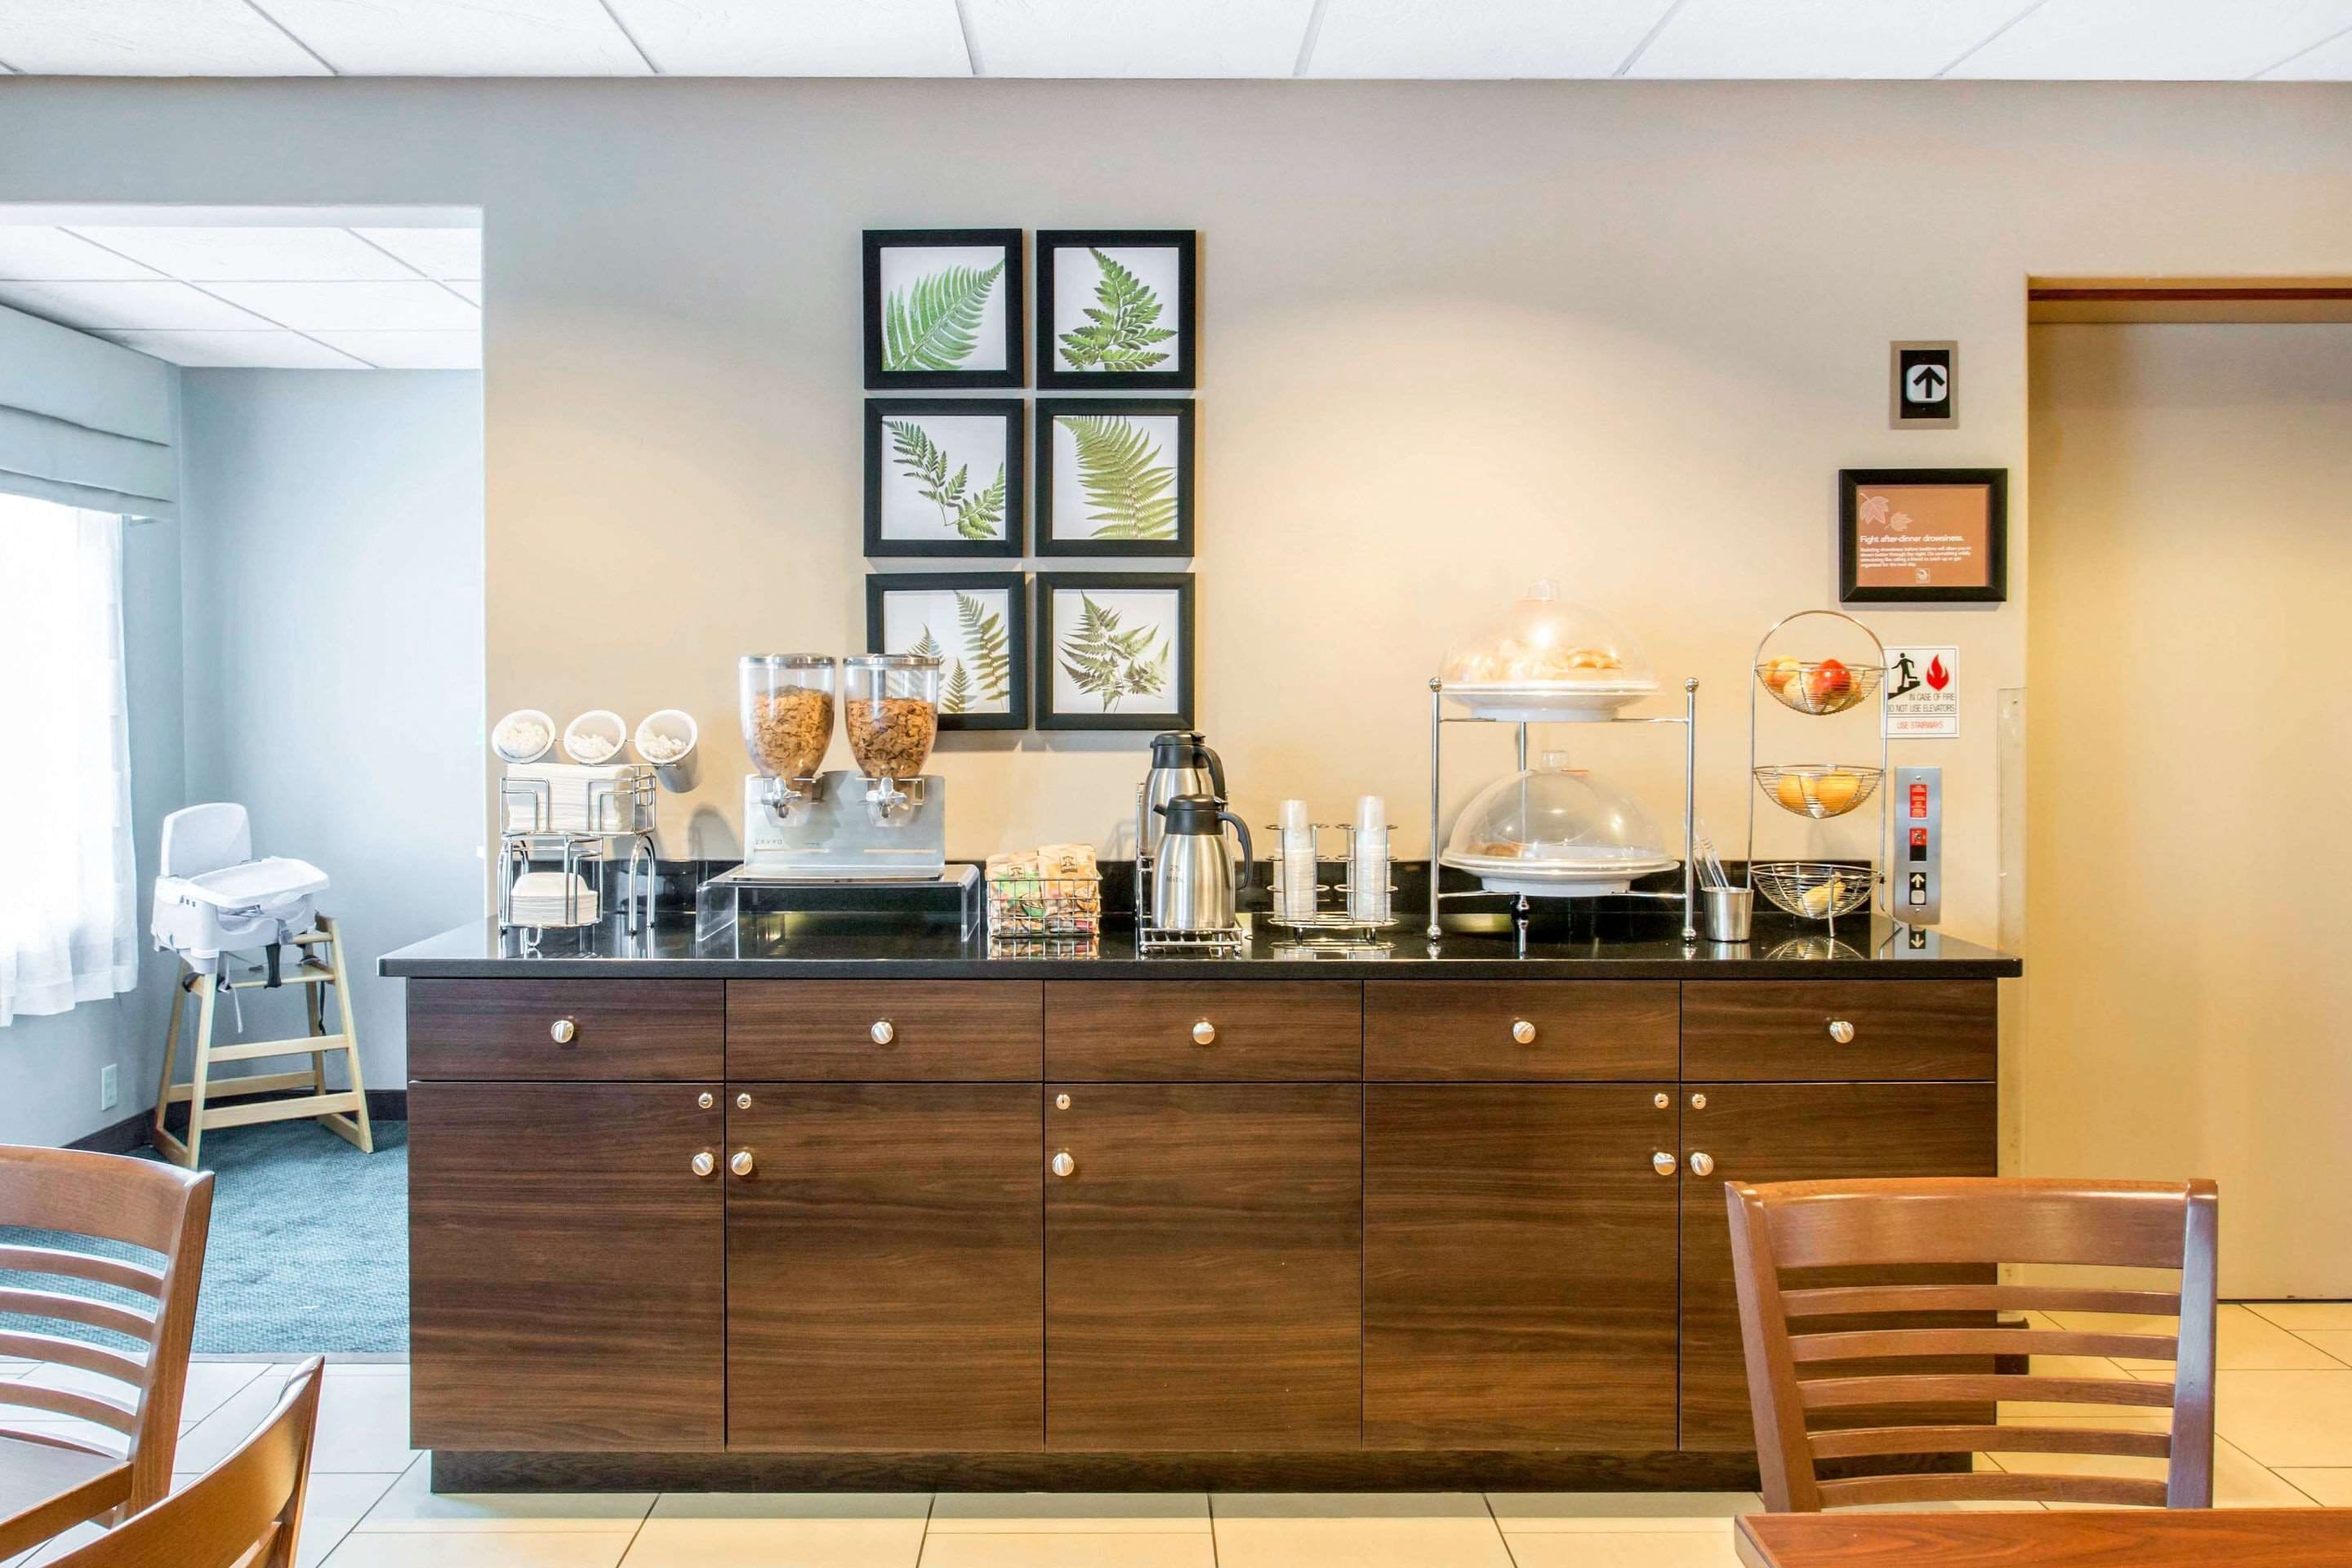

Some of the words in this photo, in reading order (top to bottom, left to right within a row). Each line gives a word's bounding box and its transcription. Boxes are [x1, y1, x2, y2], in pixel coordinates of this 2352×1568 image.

[1860, 536, 1879, 545] Fight
[1880, 535, 1922, 543] after-dinner
[1923, 534, 1964, 542] drowsiness.
[1909, 693, 1915, 701] IN
[1917, 693, 1931, 701] CASE
[1933, 693, 1940, 701] OF
[1942, 693, 1954, 701] FIRE
[1895, 704, 1908, 712] NOT
[1909, 704, 1922, 712] USE
[1922, 704, 1954, 712] ELEVATORS
[1897, 721, 1909, 729] USE
